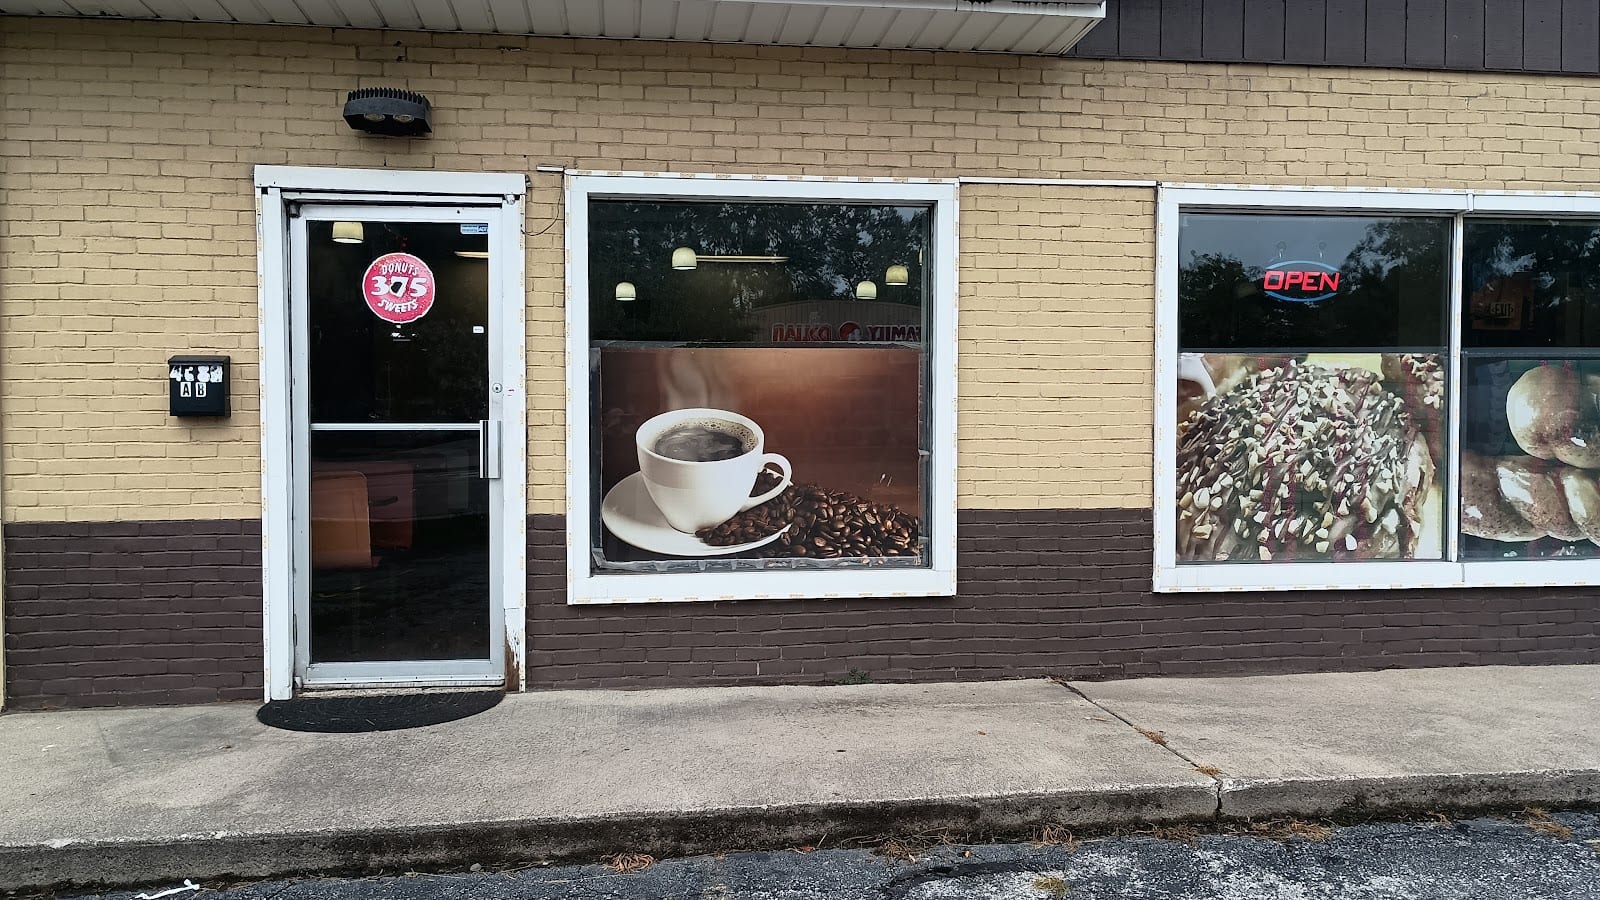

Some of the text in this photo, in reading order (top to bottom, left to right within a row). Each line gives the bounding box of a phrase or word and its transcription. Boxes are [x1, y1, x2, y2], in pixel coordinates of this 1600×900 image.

[381, 261, 420, 276] DONUTS
[370, 275, 428, 298] 375
[1263, 270, 1340, 292] OPEN
[377, 299, 418, 313] SWEETS
